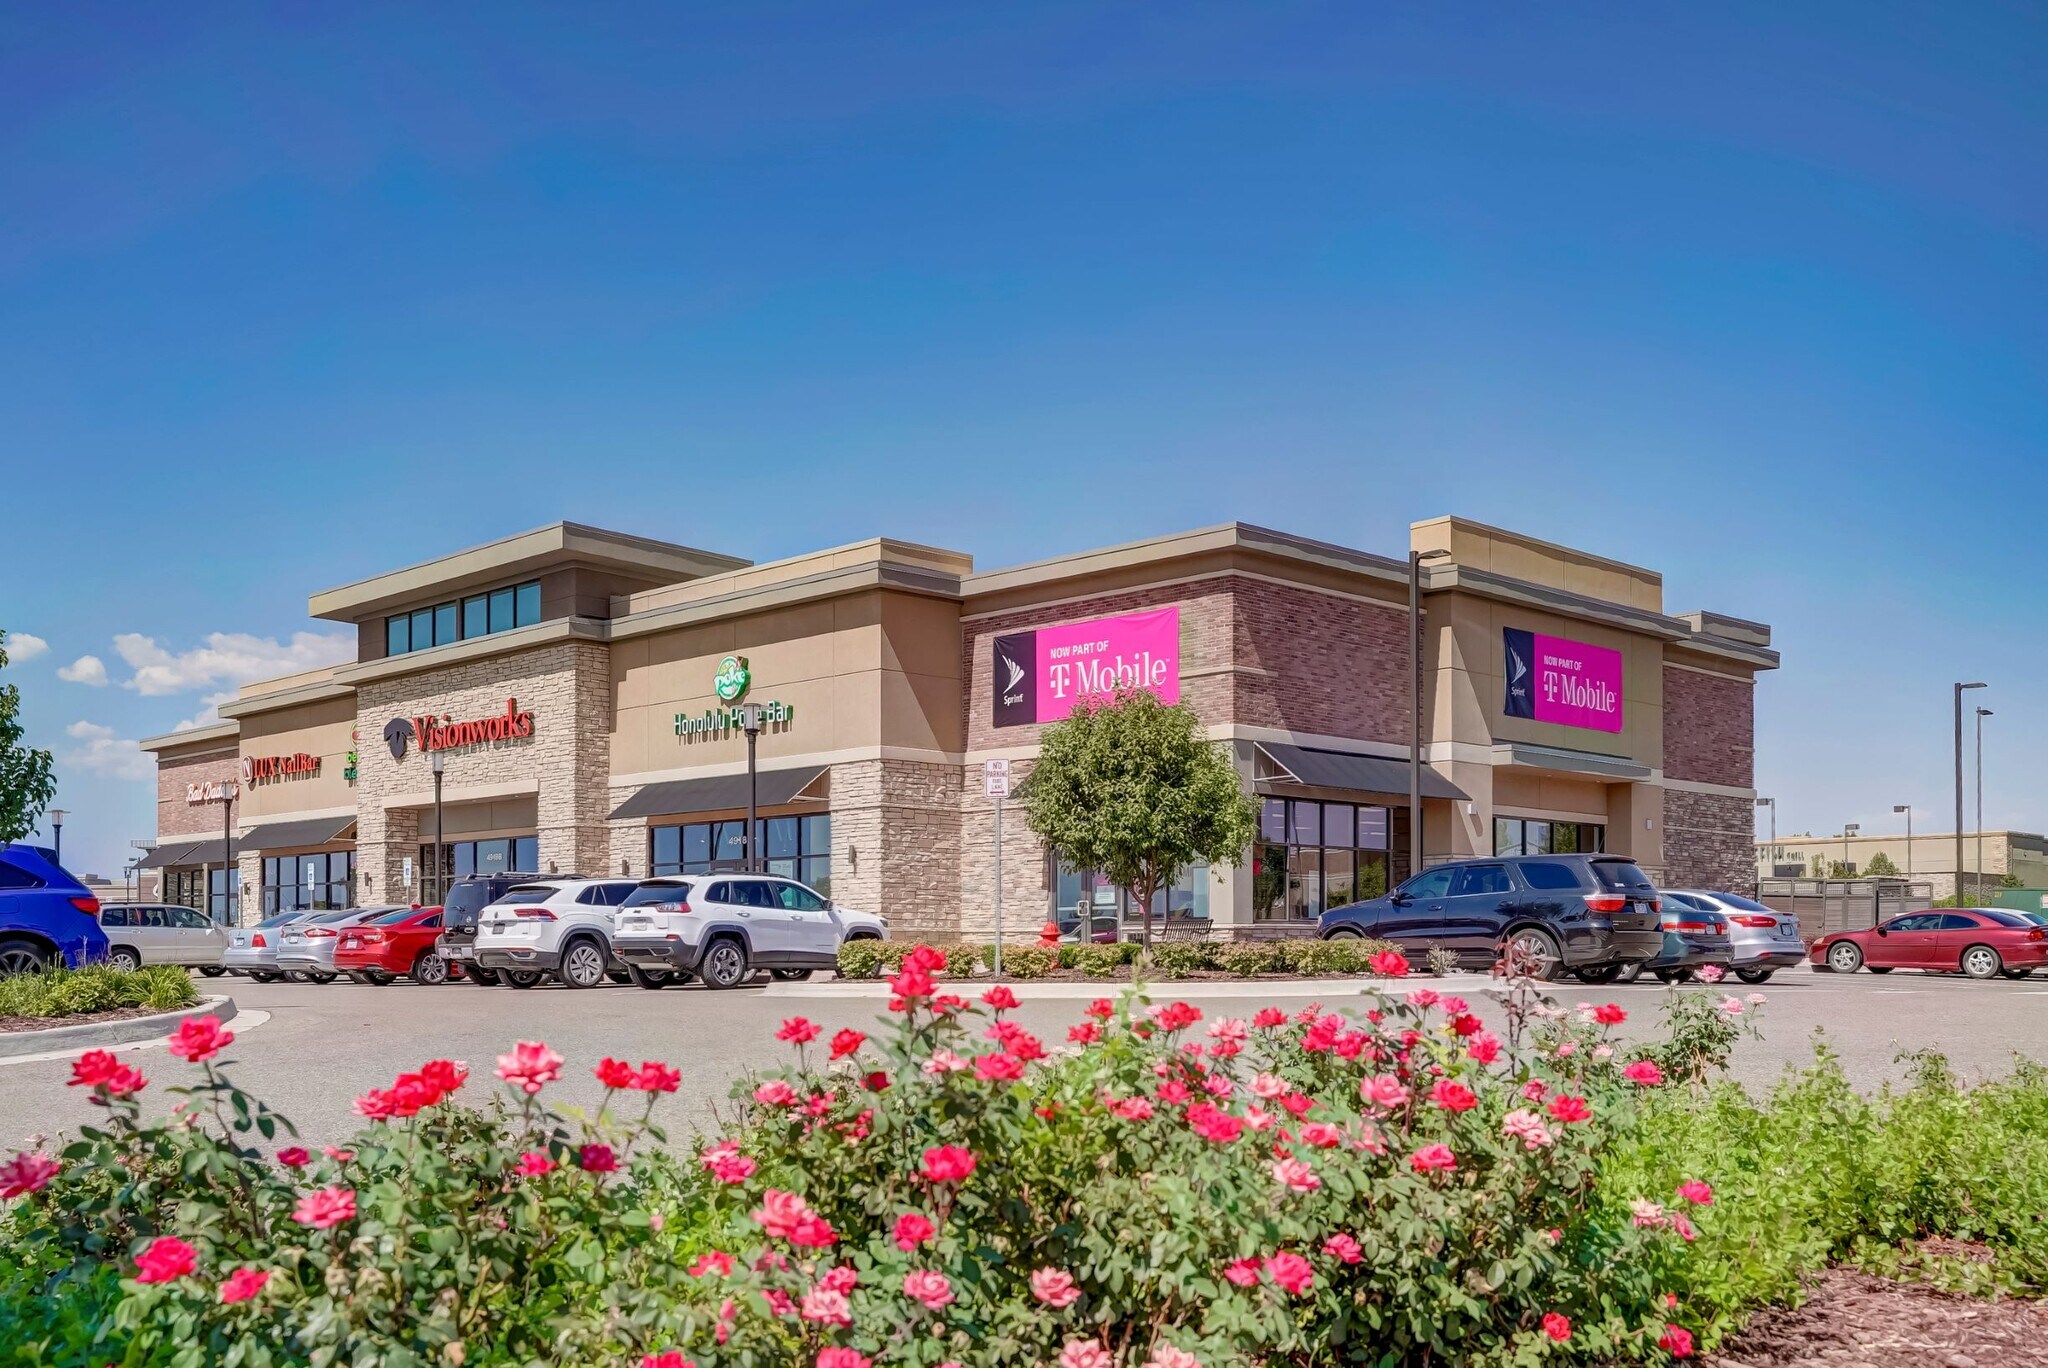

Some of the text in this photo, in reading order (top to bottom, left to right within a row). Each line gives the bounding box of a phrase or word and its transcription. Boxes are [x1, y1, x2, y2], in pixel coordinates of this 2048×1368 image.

[1050, 640, 1109, 659] NOW PART OF
[1543, 655, 1583, 671] NOW PART OF
[1075, 651, 1167, 695] Mobile
[1003, 693, 1024, 707] Sprint
[1511, 686, 1525, 697] Sprint
[1560, 673, 1615, 713] Mobile
[413, 698, 532, 751] Visionworks
[674, 700, 790, 735] Honolulu Poe Bar
[254, 757, 276, 778] LUX
[346, 752, 357, 764] be
[993, 762, 1003, 770] NO
[186, 783, 205, 802] Bad
[728, 836, 747, 845] 4918
